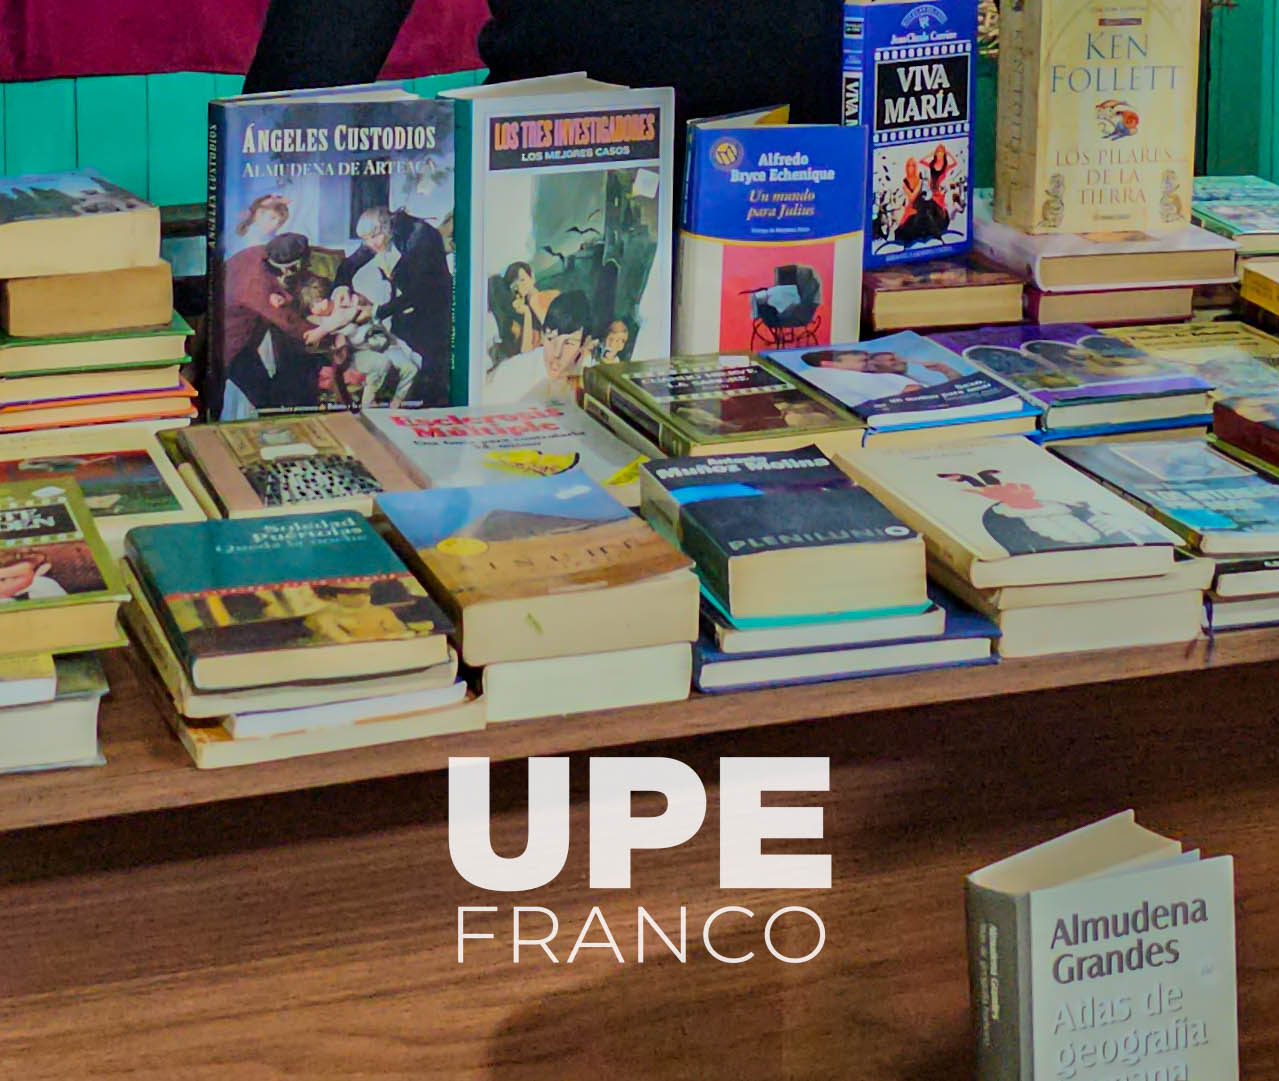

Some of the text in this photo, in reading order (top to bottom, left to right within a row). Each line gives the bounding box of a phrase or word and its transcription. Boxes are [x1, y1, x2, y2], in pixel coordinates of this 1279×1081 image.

[1086, 31, 1149, 60] KEN
[896, 63, 951, 93] VIVA
[1051, 64, 1185, 93] FOLLETT
[846, 81, 859, 117] VIVA
[883, 89, 961, 125] MARÍA
[242, 123, 436, 153] ÁNGELES CUSTODIOS
[494, 112, 655, 151] LOS TRES INVESTIGADORES
[521, 145, 630, 162] LOS MEJORES CASOS
[758, 151, 809, 166] Alfredo
[1056, 150, 1091, 167] LOS
[242, 159, 437, 178] ALMUDENA DE ARTEAGA
[729, 167, 836, 185] Bryce Echenique
[1087, 167, 1141, 185] DE LA
[748, 188, 816, 202] Un mundo
[1080, 188, 1147, 205] TIERRA
[746, 203, 816, 221] para Julius
[655, 457, 830, 479] Muñoz Molina
[707, 456, 768, 466] Antonio
[263, 517, 357, 533] Soledad
[727, 525, 911, 552] PLENILUNIO
[1050, 897, 1209, 950] Almudena
[1051, 938, 1181, 985] Grandes
[1053, 982, 1184, 1036] Atlas de
